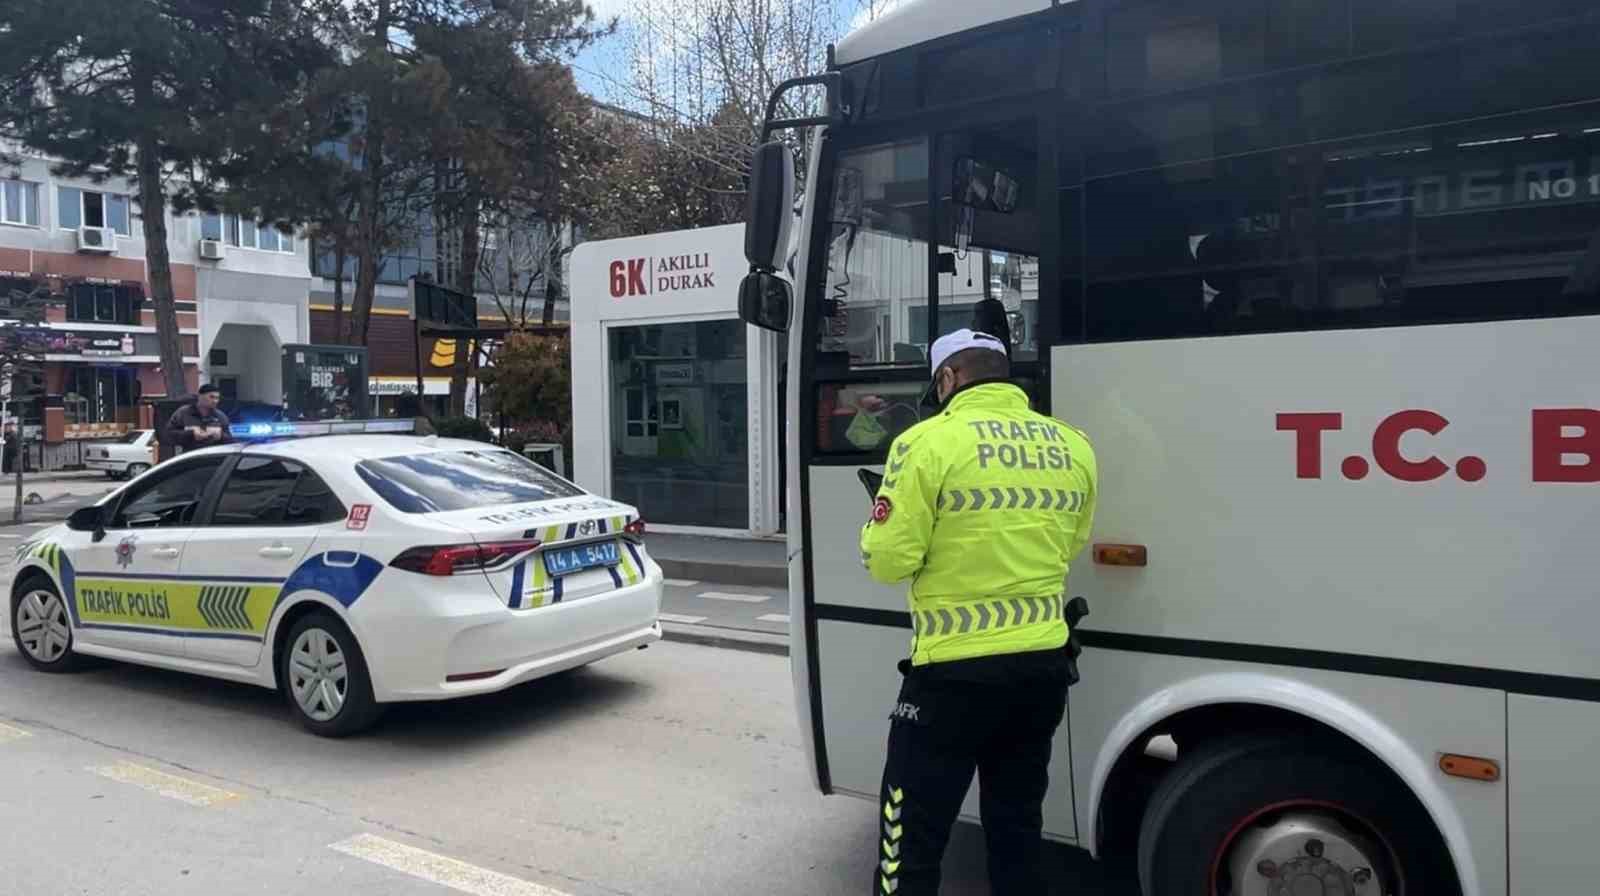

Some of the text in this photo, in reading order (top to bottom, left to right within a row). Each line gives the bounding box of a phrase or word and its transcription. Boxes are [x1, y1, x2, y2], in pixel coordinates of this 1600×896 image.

[1528, 178, 1576, 201] NO
[658, 252, 709, 272] AKILLI
[609, 258, 647, 298] 6K
[658, 272, 715, 292] DURAK
[968, 419, 1067, 443] TRAFİK
[977, 443, 1073, 471] POLİSİ
[1276, 408, 1600, 482] T.C. B
[549, 543, 617, 570] 14 A 5417
[81, 587, 170, 619] TRAFİK POLİSİ
